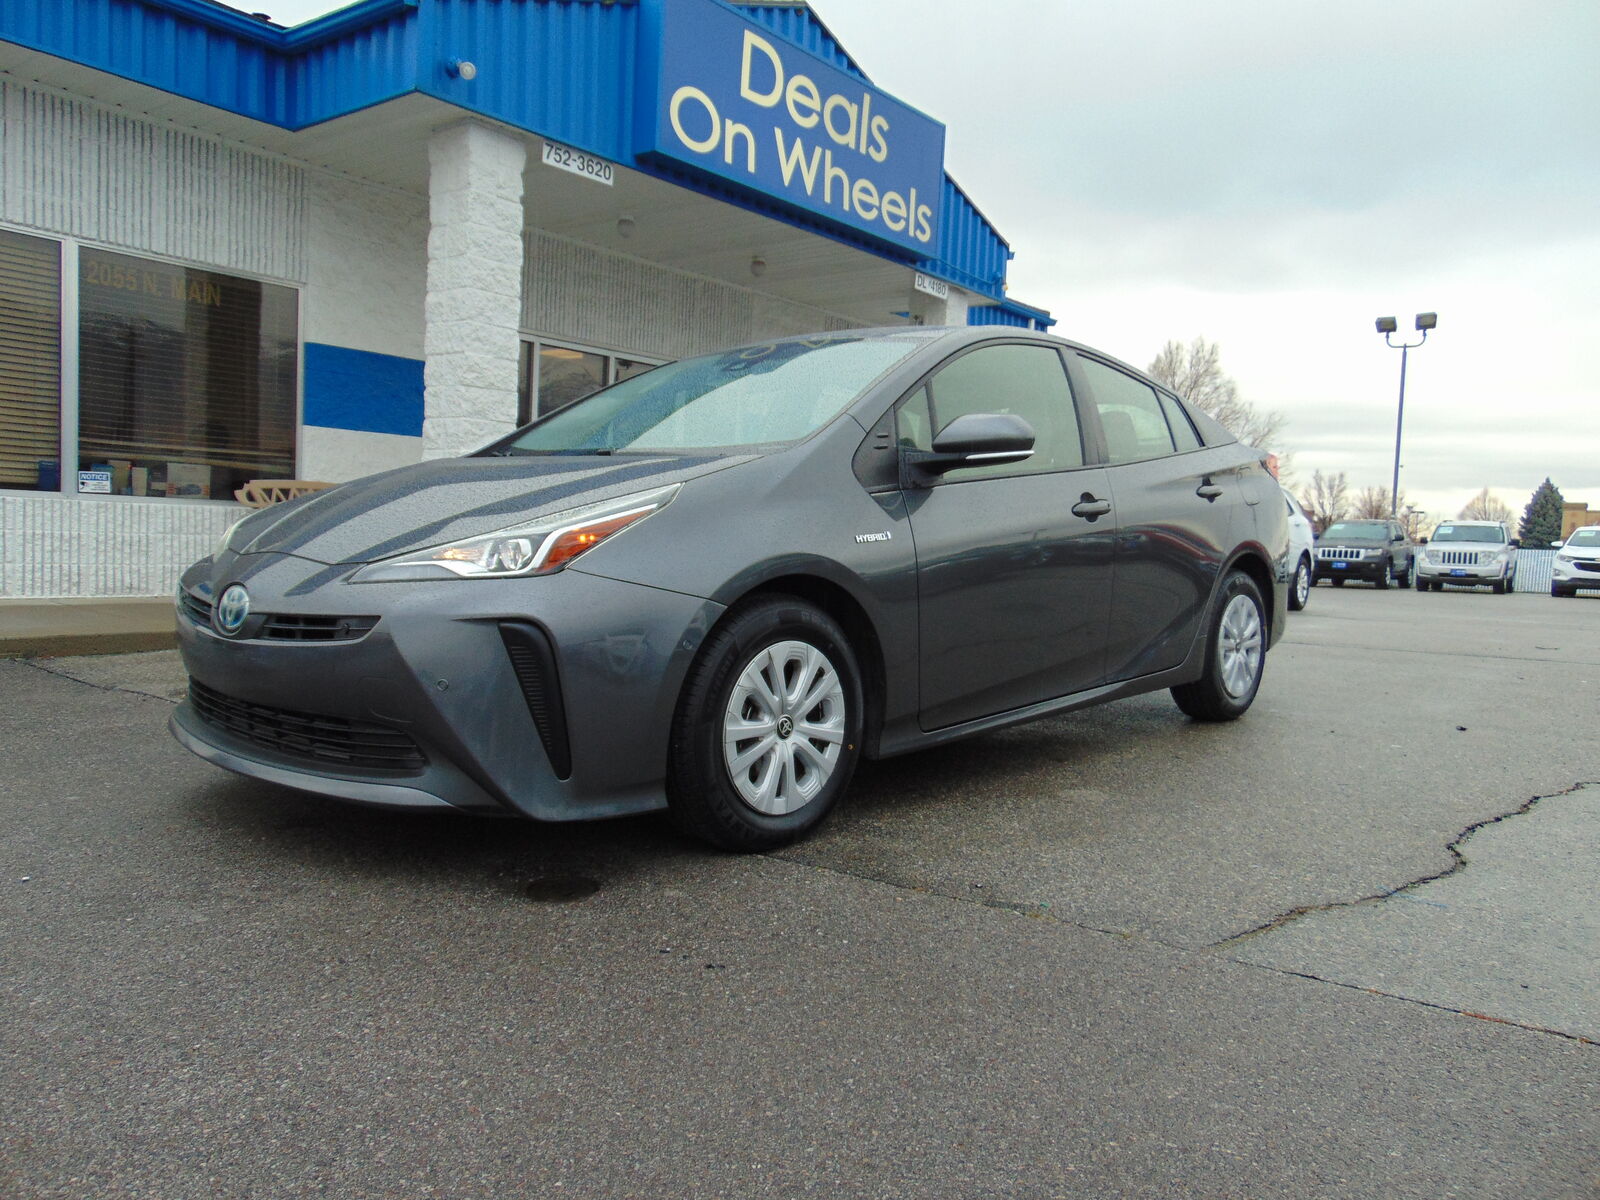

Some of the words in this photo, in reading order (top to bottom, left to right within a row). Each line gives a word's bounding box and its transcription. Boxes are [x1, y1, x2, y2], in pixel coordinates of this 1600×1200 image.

[740, 29, 889, 163] Deals
[544, 142, 612, 180] 752-3620
[669, 86, 756, 173] On
[774, 126, 932, 243] Wheels
[87, 260, 137, 291] 2055
[80, 473, 108, 481] NOTICE
[856, 533, 887, 543] HYBRID
